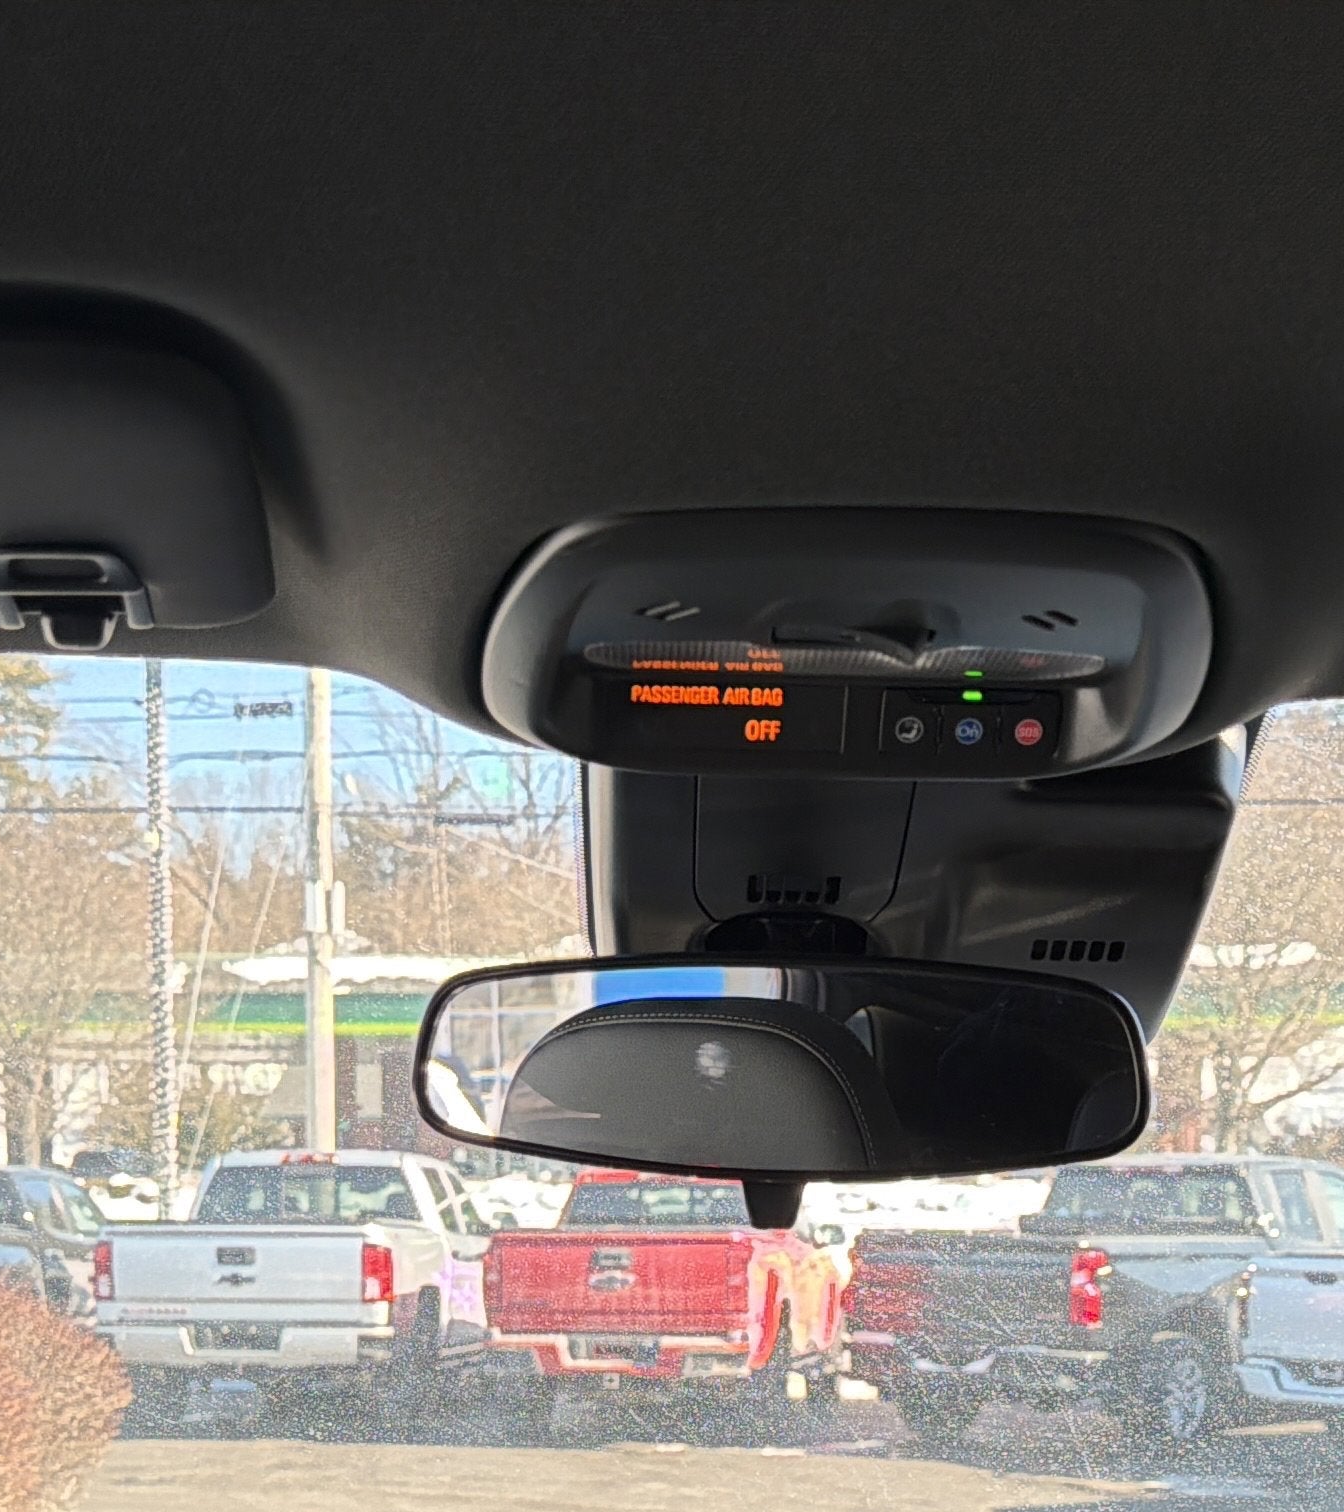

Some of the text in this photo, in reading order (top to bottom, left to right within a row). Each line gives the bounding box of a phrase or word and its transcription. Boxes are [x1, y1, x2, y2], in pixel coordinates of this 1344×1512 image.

[631, 685, 784, 707] PASSENGER AIR BAG
[744, 719, 782, 741] OFF
[1017, 726, 1040, 739] SOS
